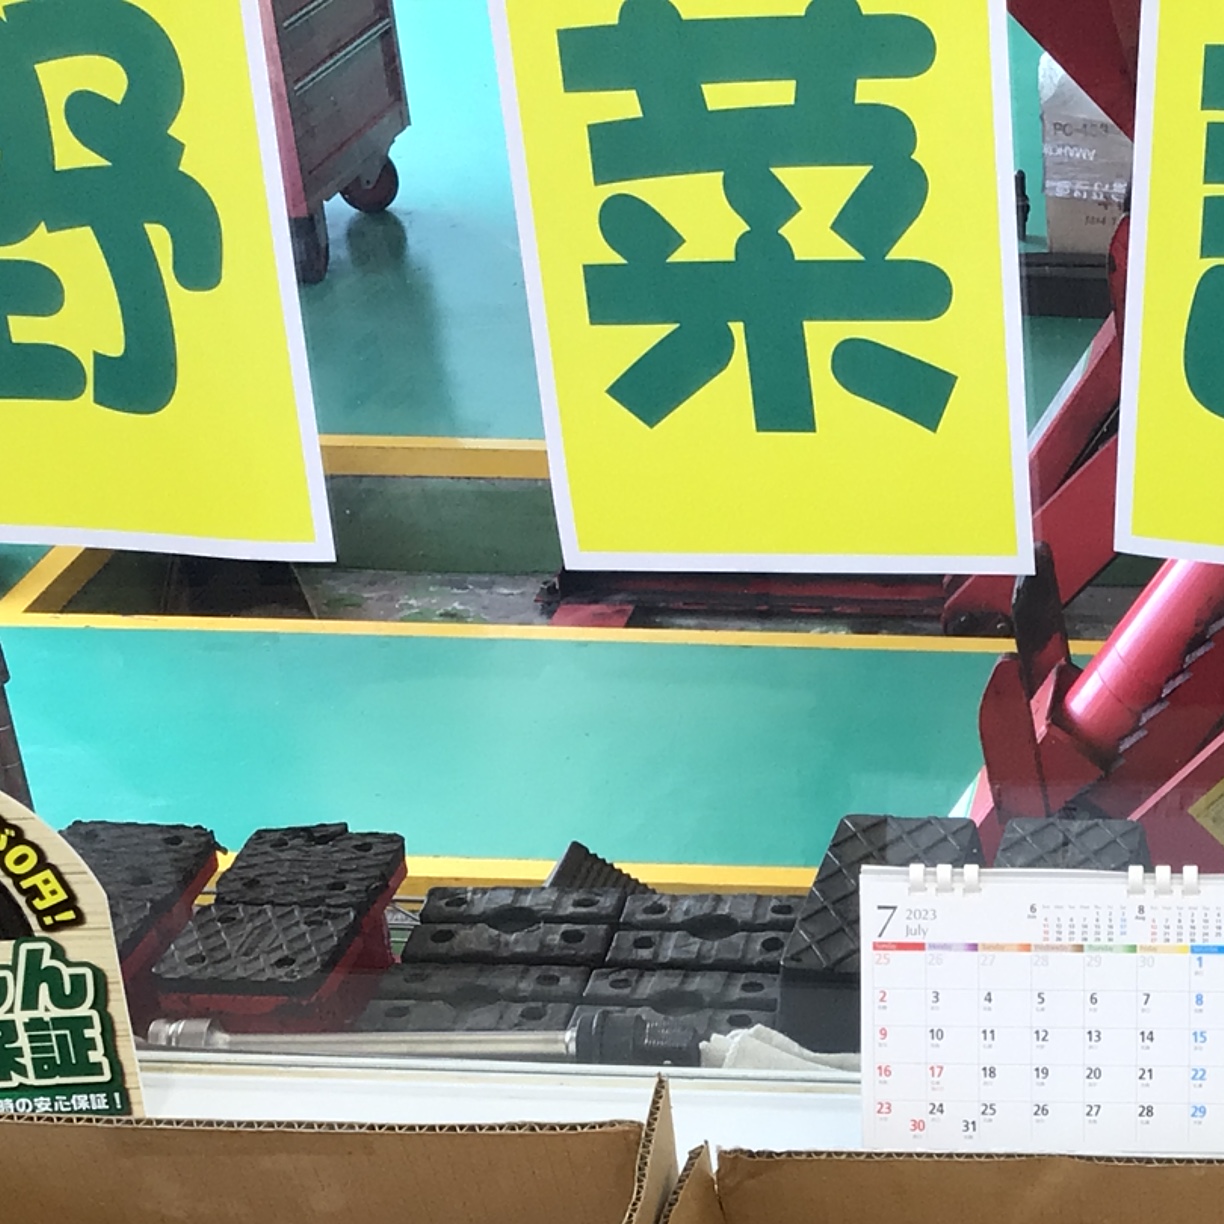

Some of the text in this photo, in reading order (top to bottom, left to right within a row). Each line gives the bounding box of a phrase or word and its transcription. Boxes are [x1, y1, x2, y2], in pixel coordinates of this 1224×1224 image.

[558, 0, 959, 433] 菜
[1030, 904, 1036, 913] 6
[1138, 905, 1144, 914] 8
[877, 905, 937, 937] 7 2023
[906, 924, 928, 939] July
[1197, 956, 1202, 968] 1
[879, 991, 1203, 1005] 2 3 4 5 6 7 8
[879, 1027, 1207, 1043] 9 10 11 12 13 14 15
[877, 1065, 1206, 1080] 16 17 18 19 20 21 22
[877, 1102, 1206, 1118] 23 24 25 26 27 28 29
[910, 1119, 976, 1132] 30 31
